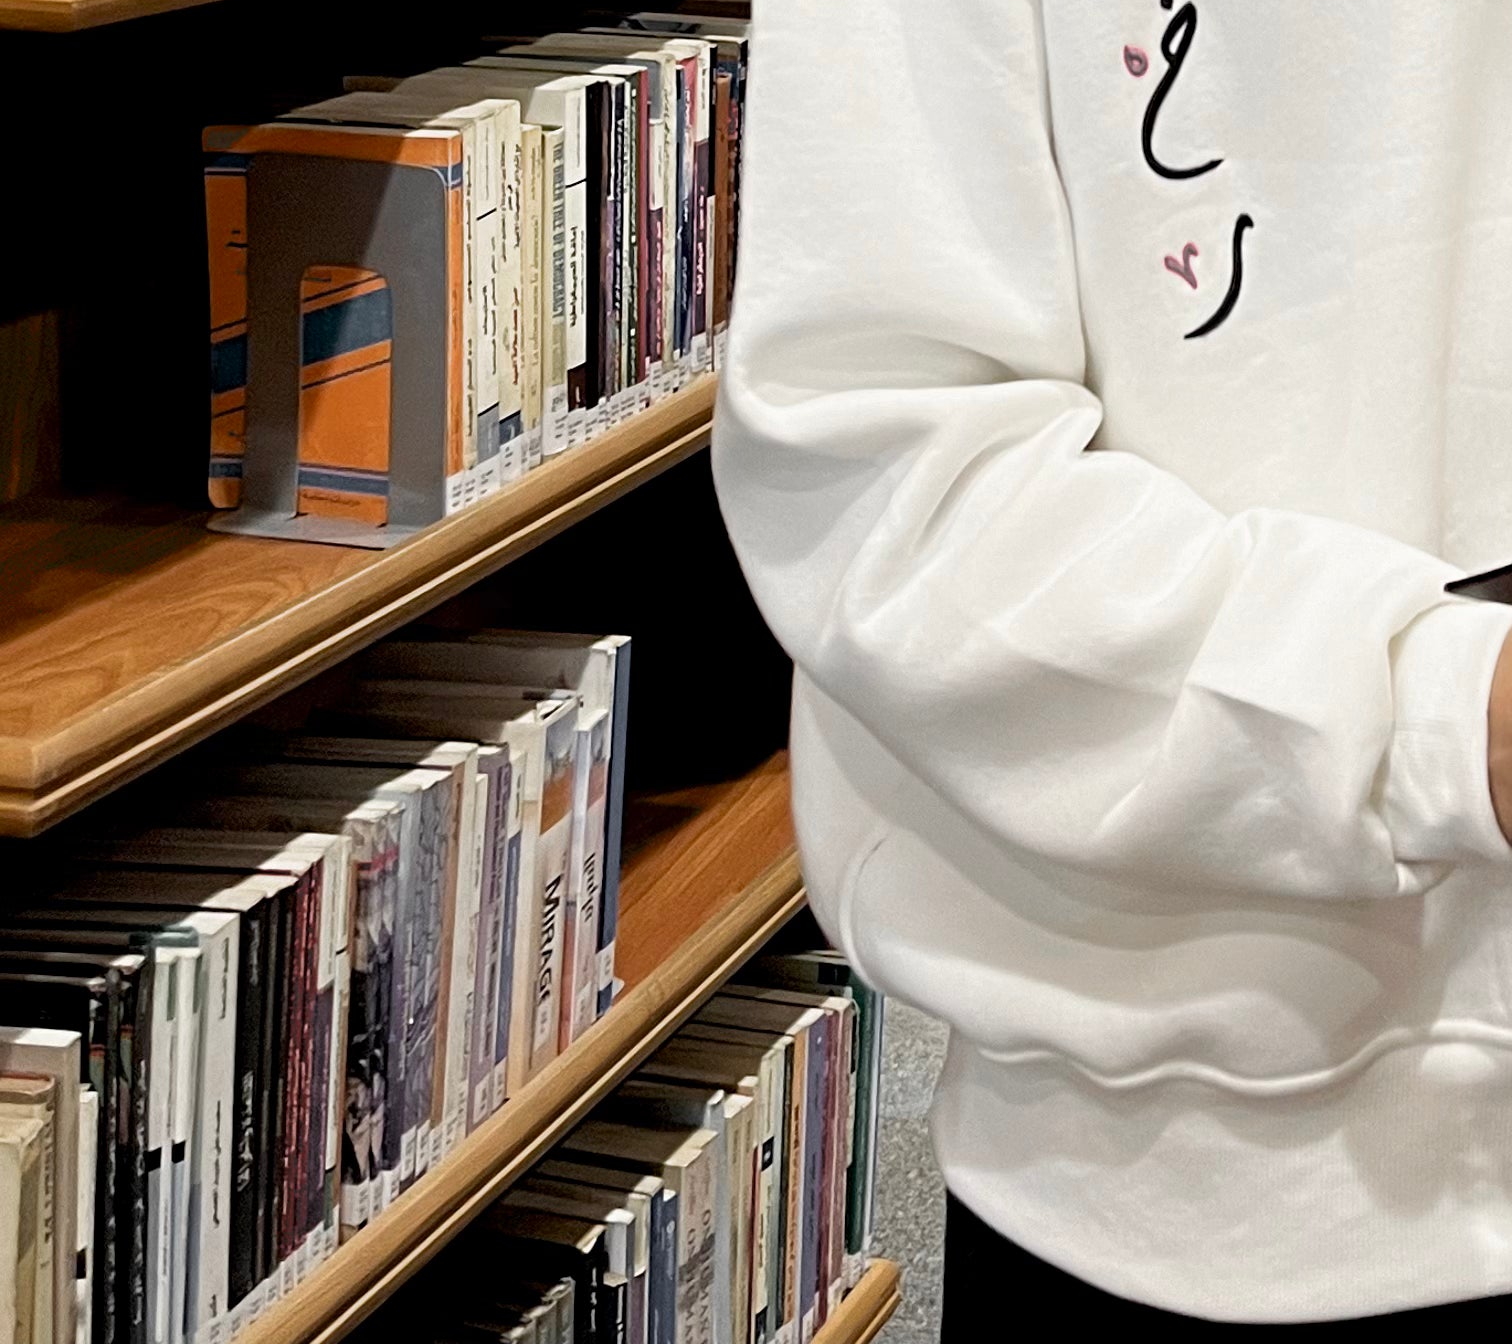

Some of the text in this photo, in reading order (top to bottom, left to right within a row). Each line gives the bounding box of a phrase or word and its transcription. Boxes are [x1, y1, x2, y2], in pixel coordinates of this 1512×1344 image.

[552, 141, 565, 161] THE
[552, 164, 565, 201] GREEN
[551, 204, 565, 229] TREE
[551, 249, 565, 320] DEMOCRACY
